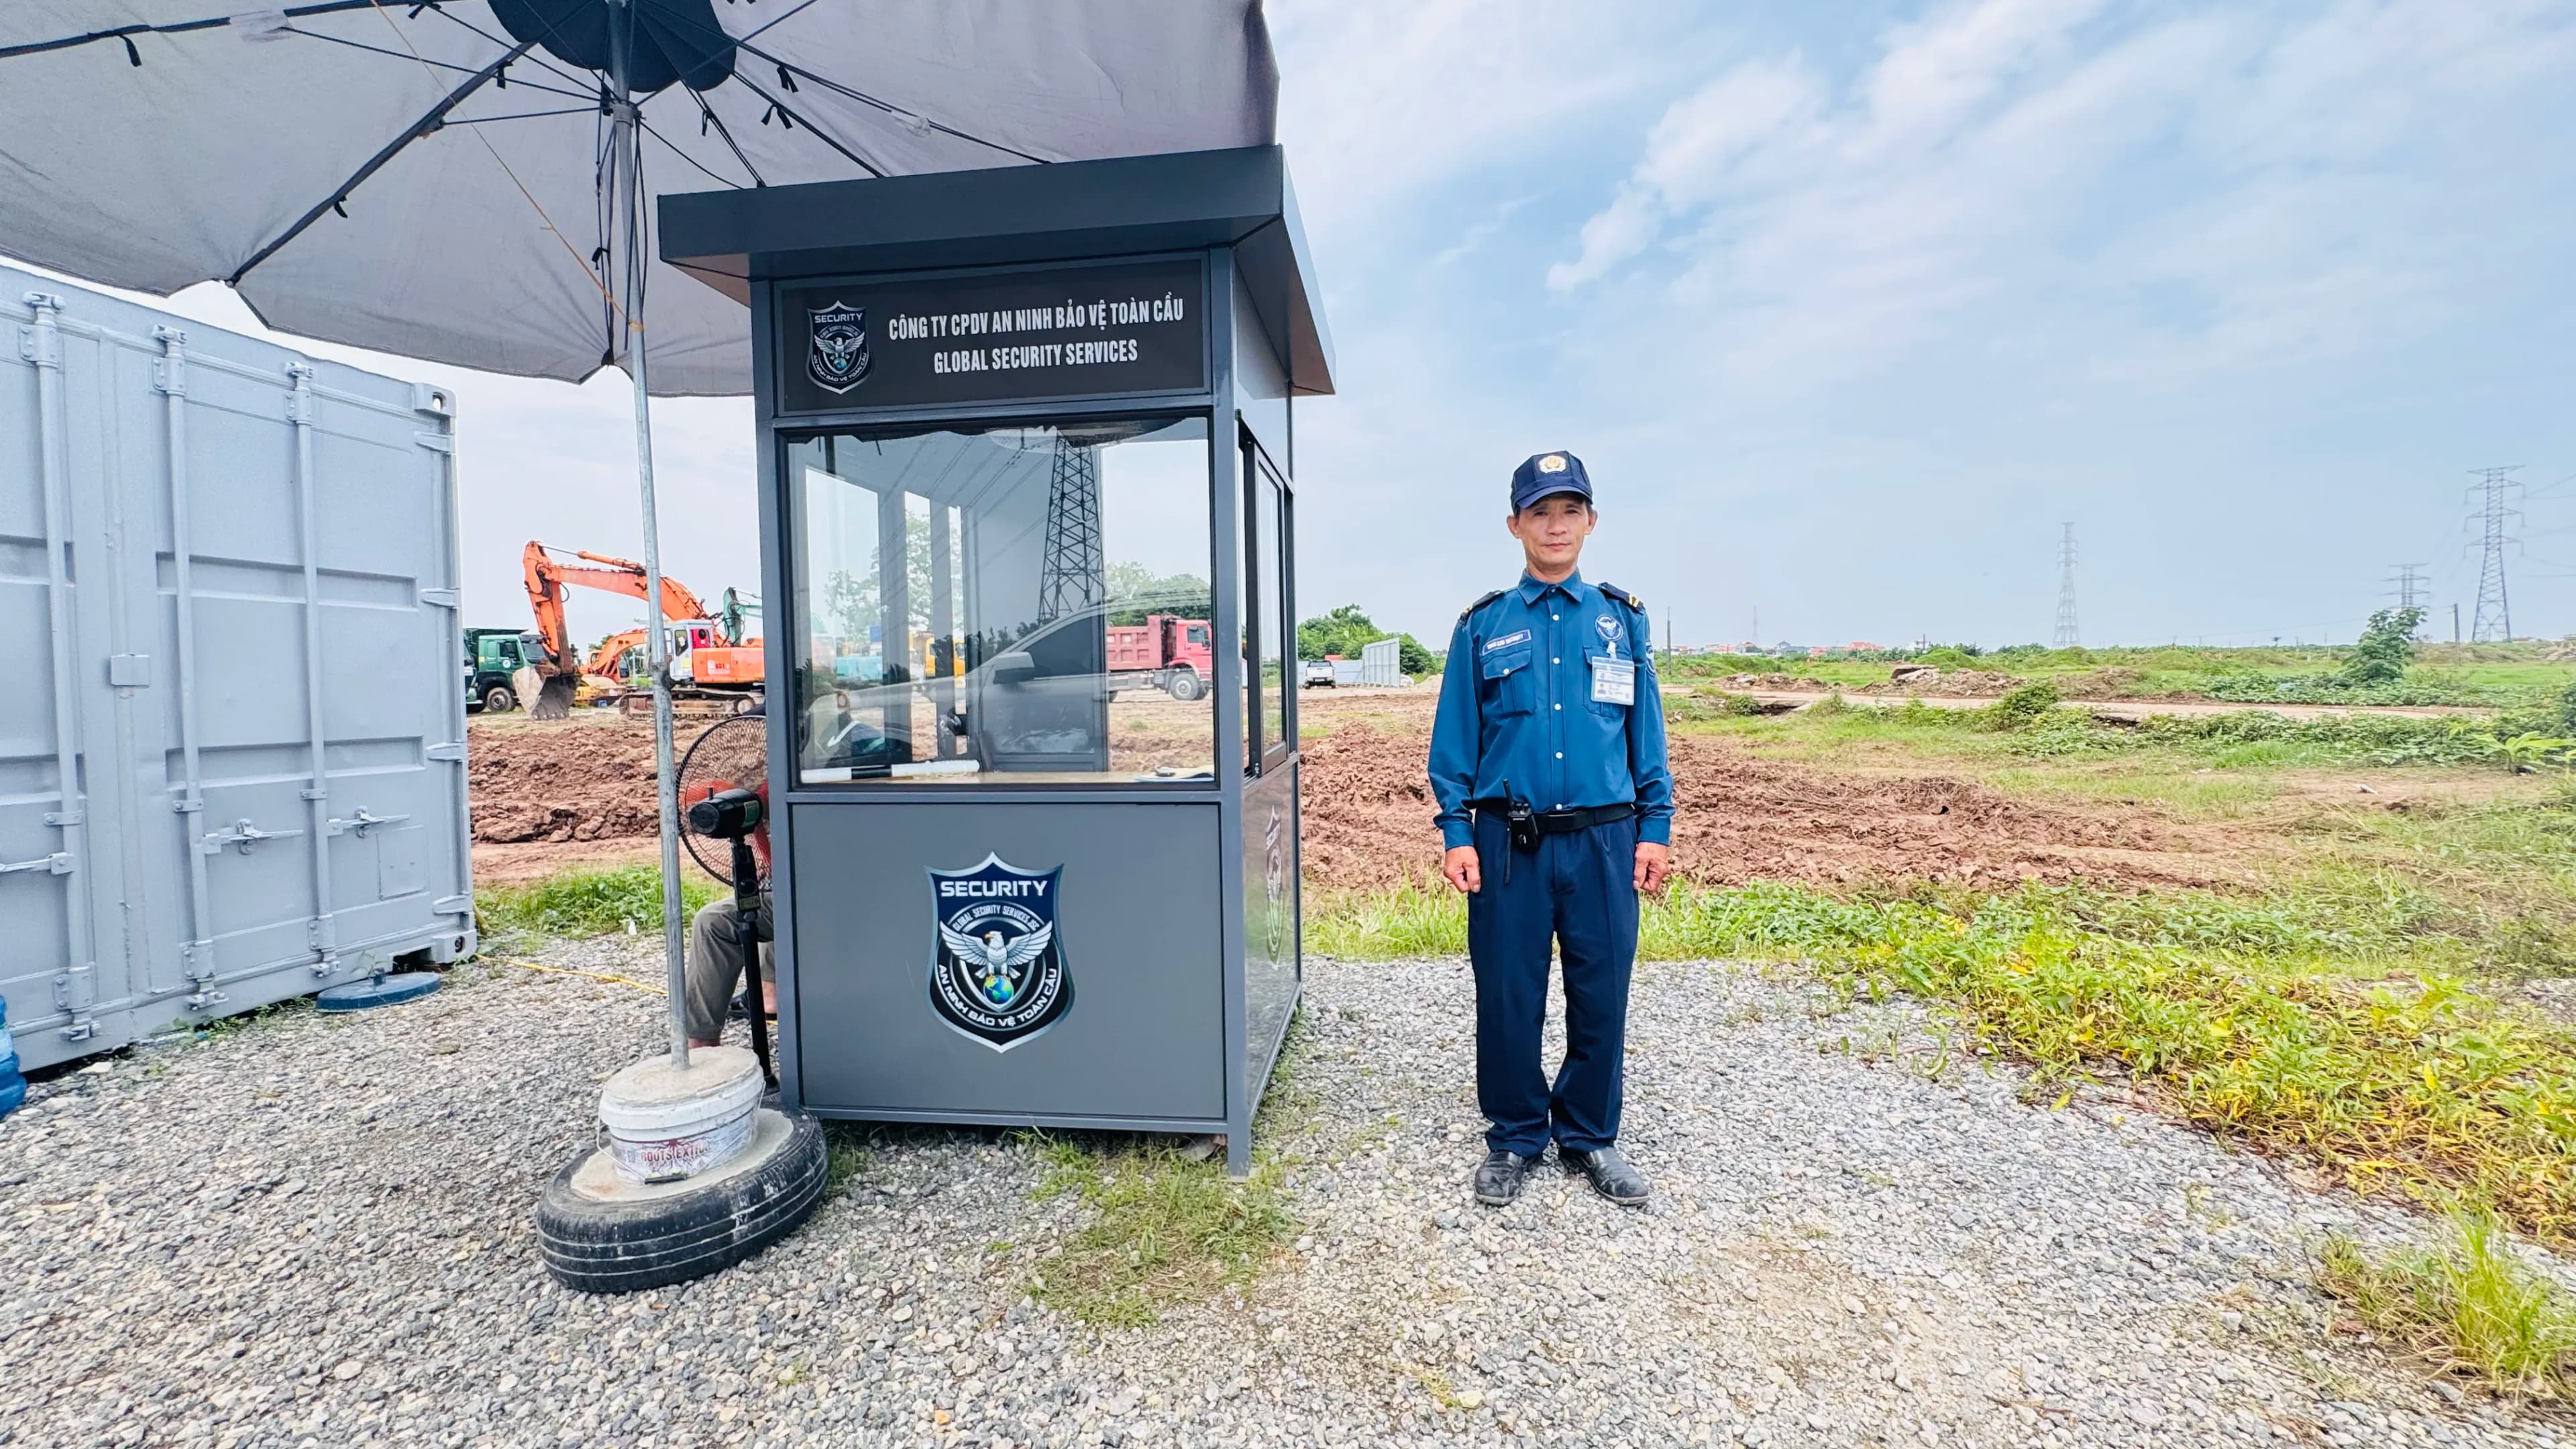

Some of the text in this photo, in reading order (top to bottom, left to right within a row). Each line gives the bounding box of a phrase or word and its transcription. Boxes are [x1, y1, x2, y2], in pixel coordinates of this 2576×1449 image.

[814, 313, 863, 323] SECURITY
[889, 314, 928, 340] CÔNG
[931, 315, 947, 337] TY
[951, 313, 988, 336] CPDV
[992, 311, 1012, 333] AN
[1016, 308, 1052, 331] NINH
[1056, 299, 1085, 329] BẢO
[1089, 299, 1106, 330] VỆ
[1110, 297, 1149, 325] TOÀN
[1153, 291, 1183, 322] CẦU
[934, 339, 1138, 374] GLOBAL SECURITY SERVICES
[941, 881, 1048, 897] SECURITY
[938, 965, 950, 985] AN
[945, 987, 969, 1014] NINH
[998, 1016, 1016, 1027] VỆ
